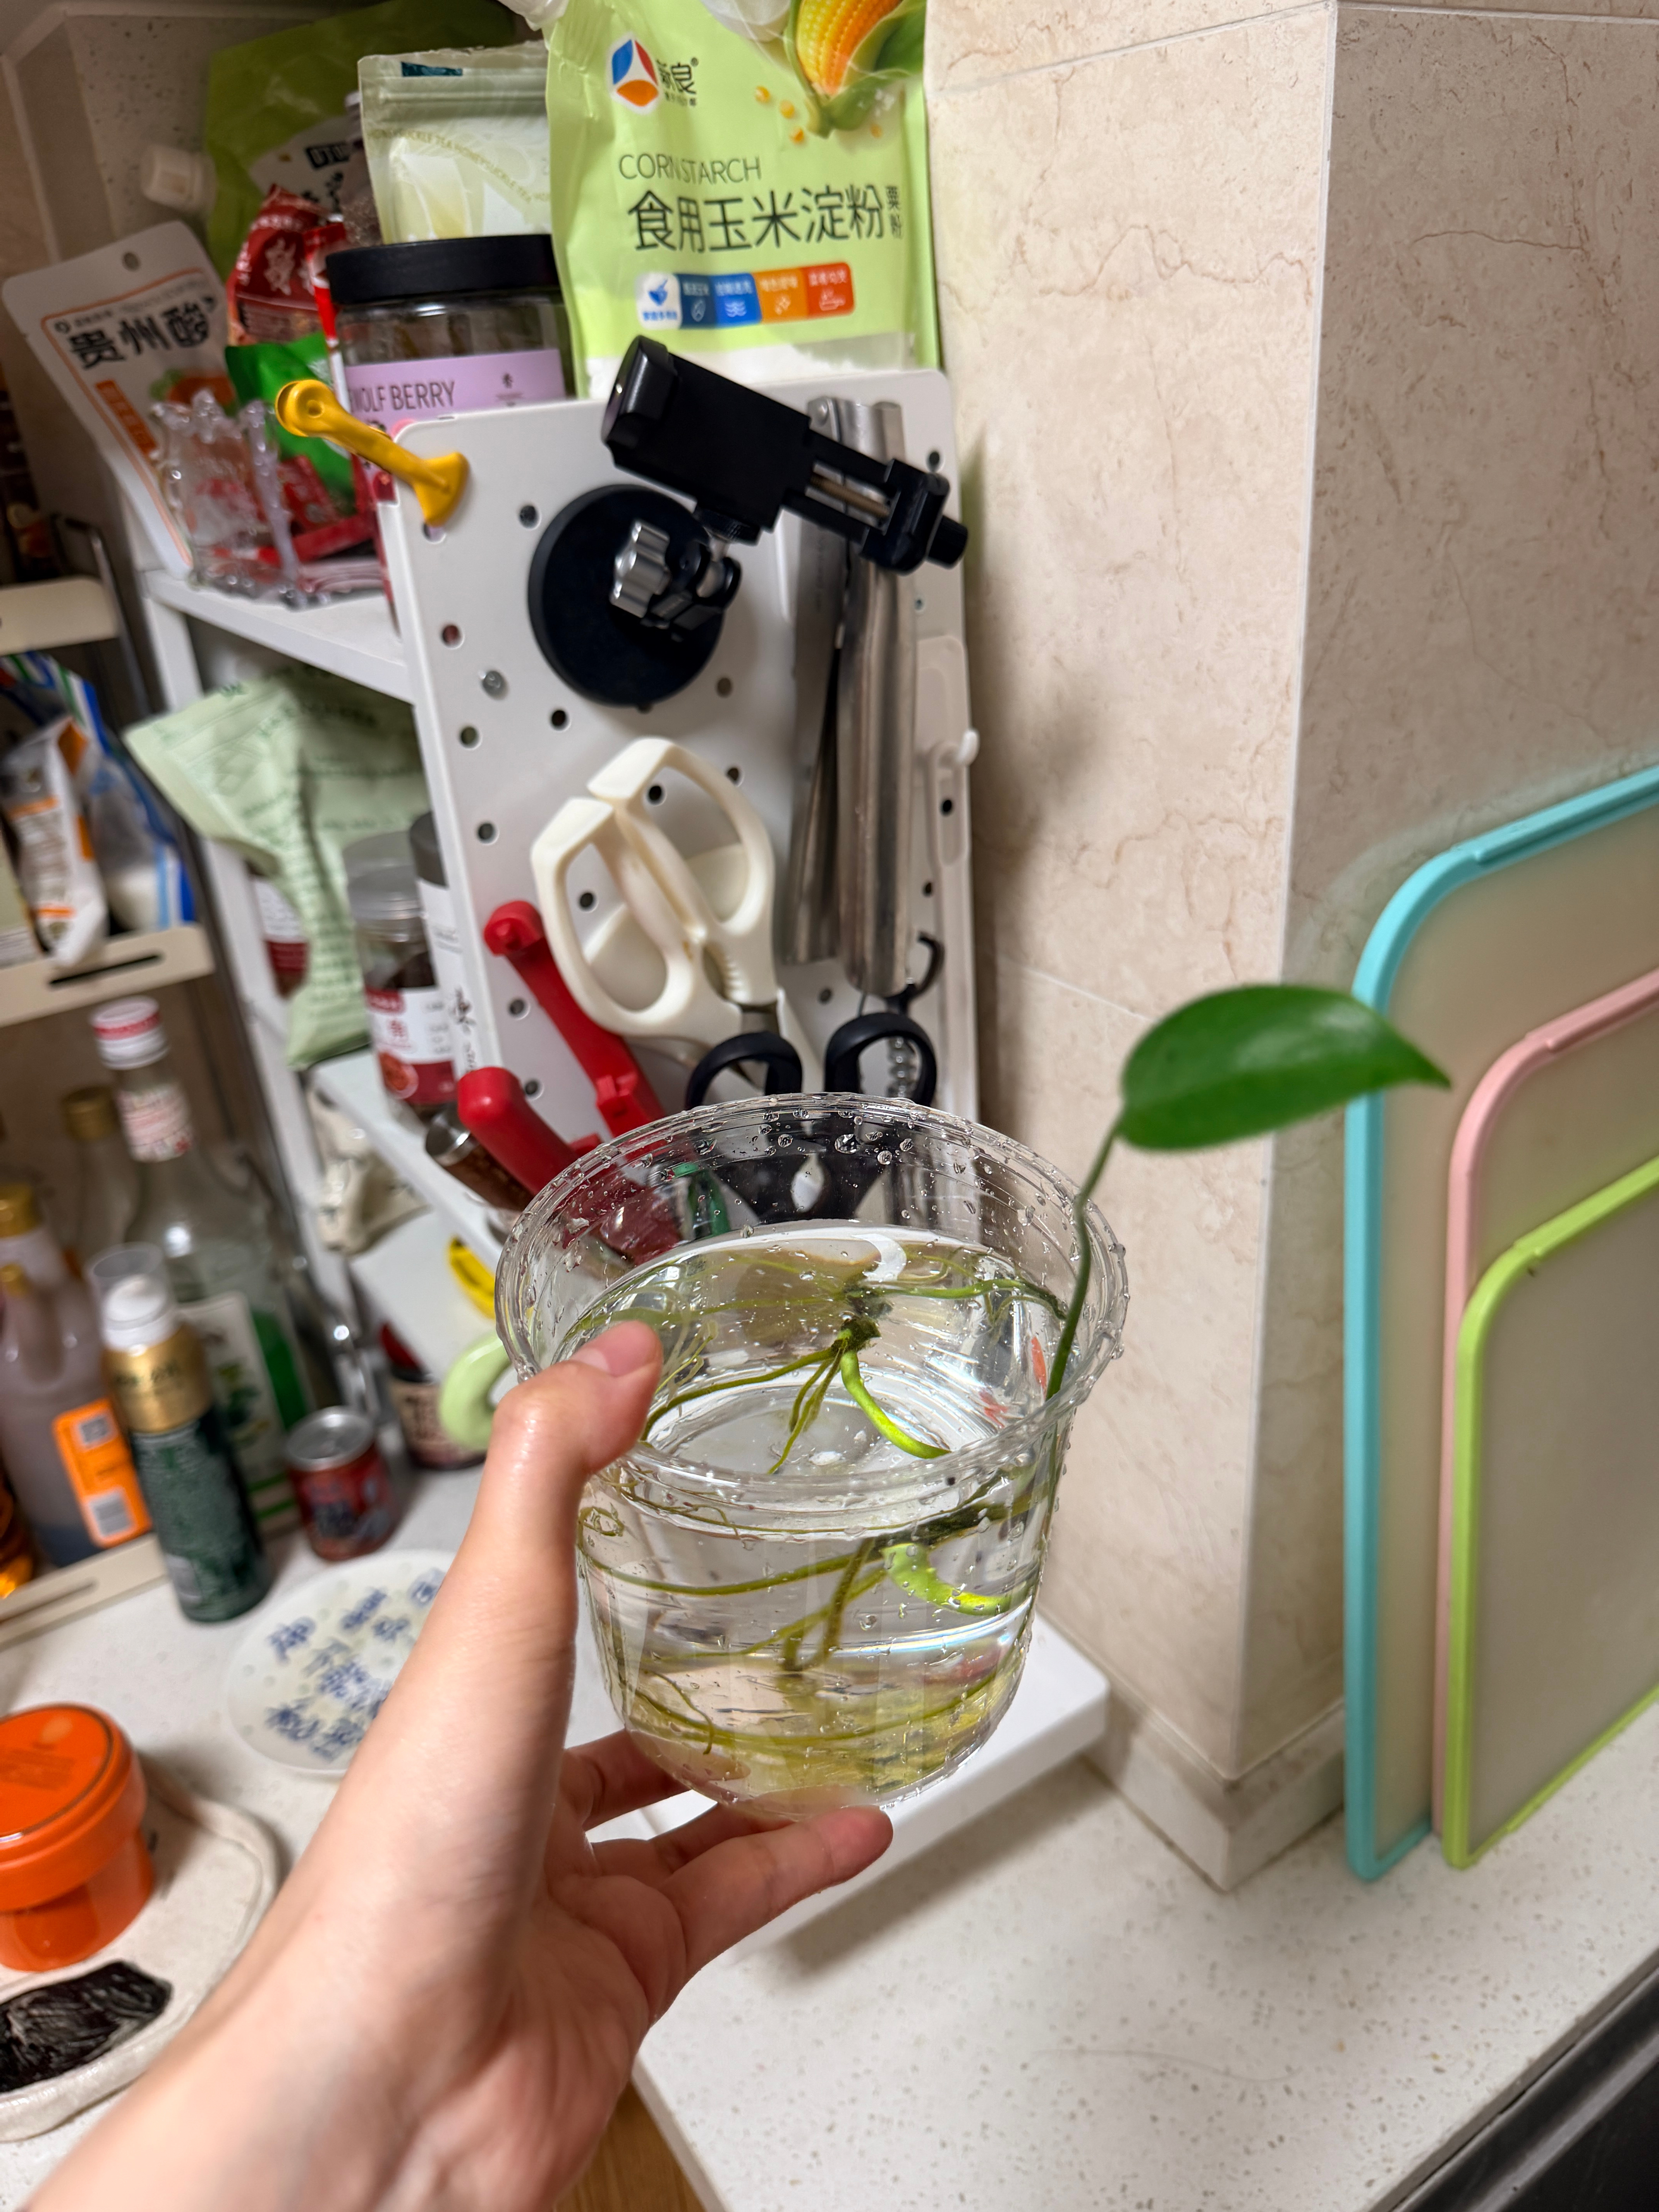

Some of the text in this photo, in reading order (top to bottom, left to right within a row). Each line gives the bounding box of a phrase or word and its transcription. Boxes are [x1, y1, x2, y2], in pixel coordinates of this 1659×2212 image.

[628, 183, 884, 253] 食用玉米淀粉
[390, 381, 456, 411] BERRY
